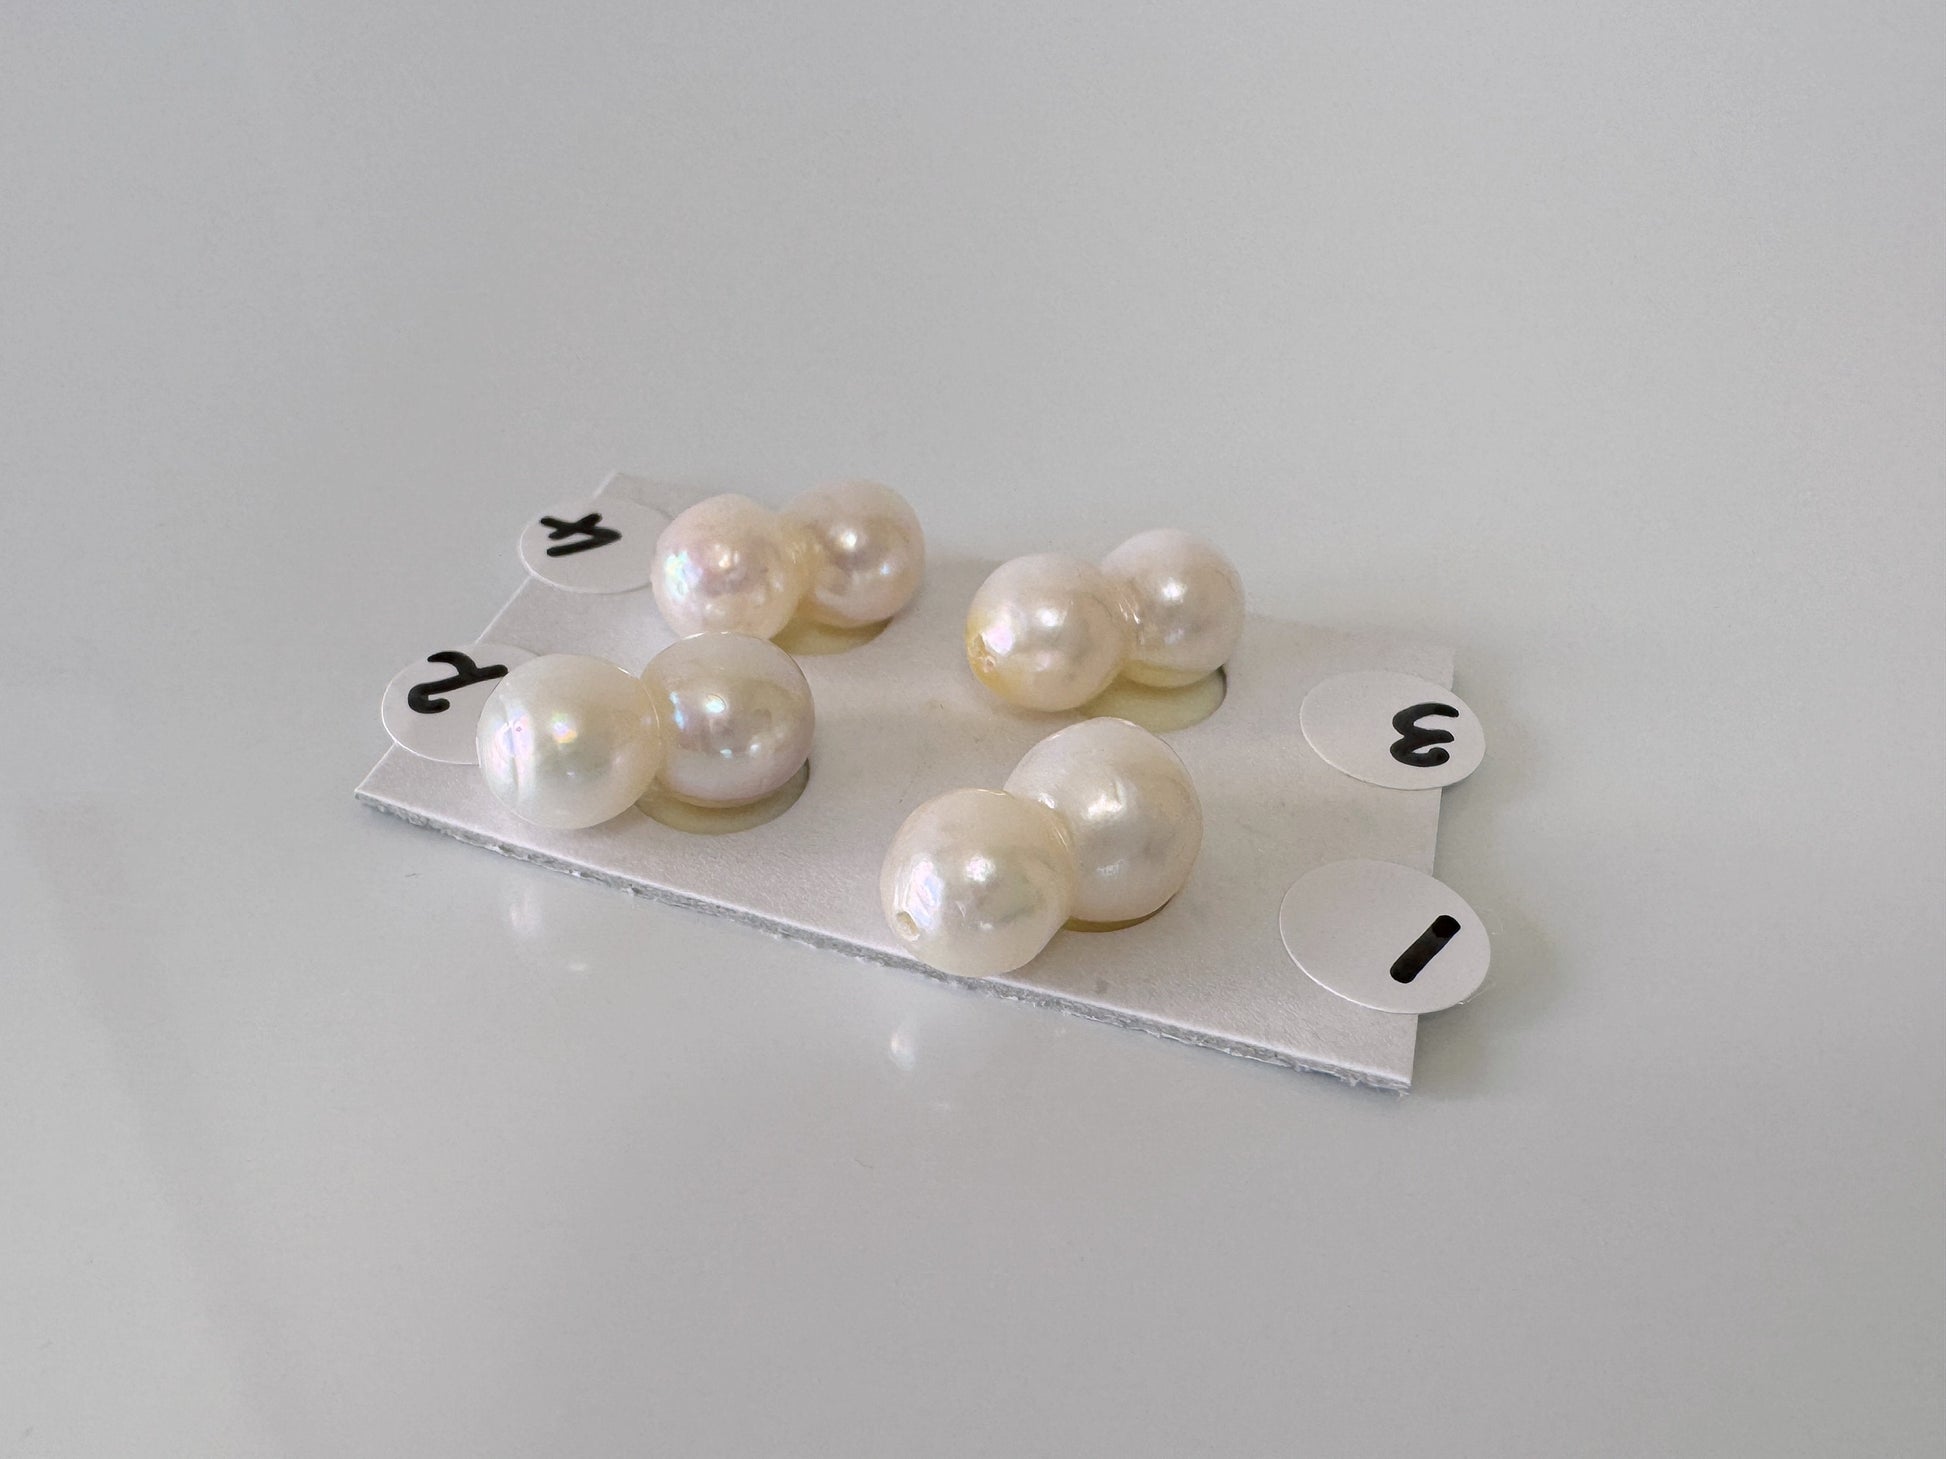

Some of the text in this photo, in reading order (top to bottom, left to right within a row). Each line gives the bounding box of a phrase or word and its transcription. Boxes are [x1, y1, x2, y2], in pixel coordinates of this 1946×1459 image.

[540, 512, 622, 557] 4
[407, 651, 509, 714] 2
[1389, 703, 1460, 768] 3
